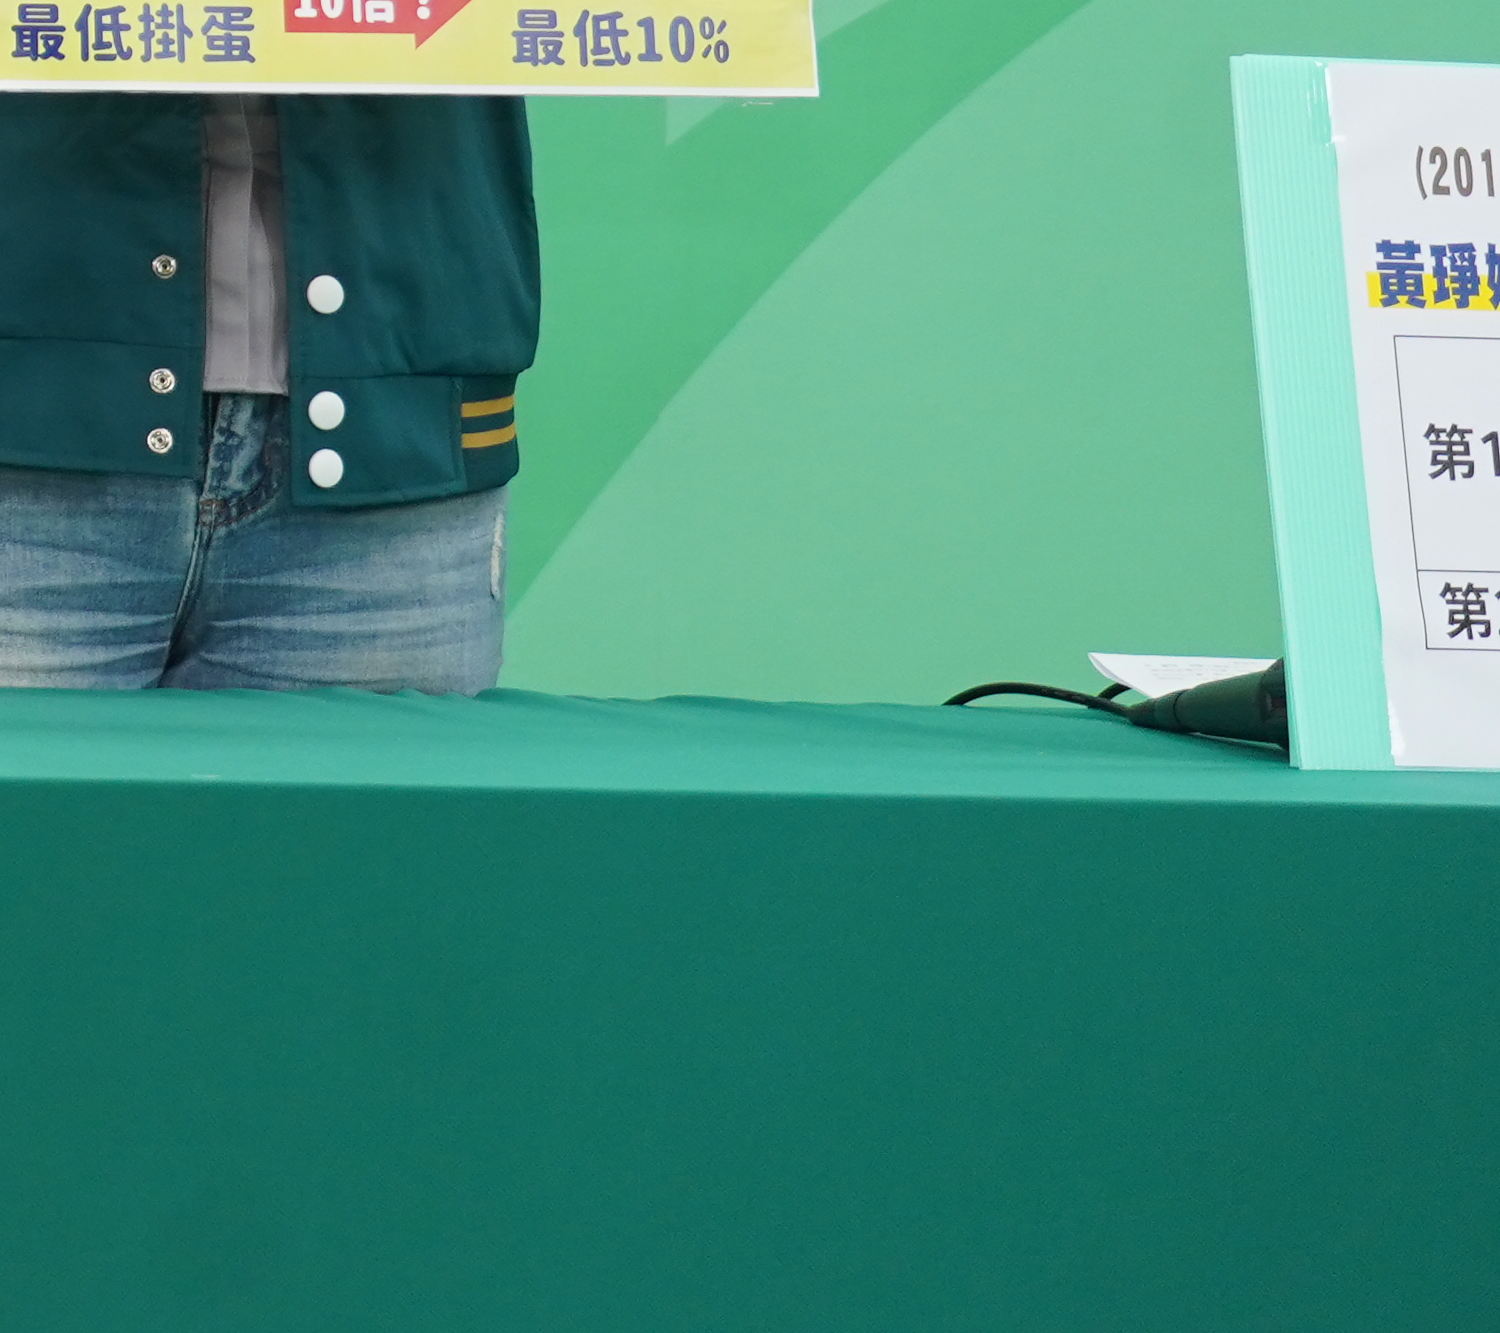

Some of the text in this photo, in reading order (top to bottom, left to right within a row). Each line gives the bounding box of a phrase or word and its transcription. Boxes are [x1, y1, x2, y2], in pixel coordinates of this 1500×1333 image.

[11, 3, 257, 64] 最低掛蛋
[512, 9, 731, 68] 最低10%
[1439, 582, 1500, 640] 第
